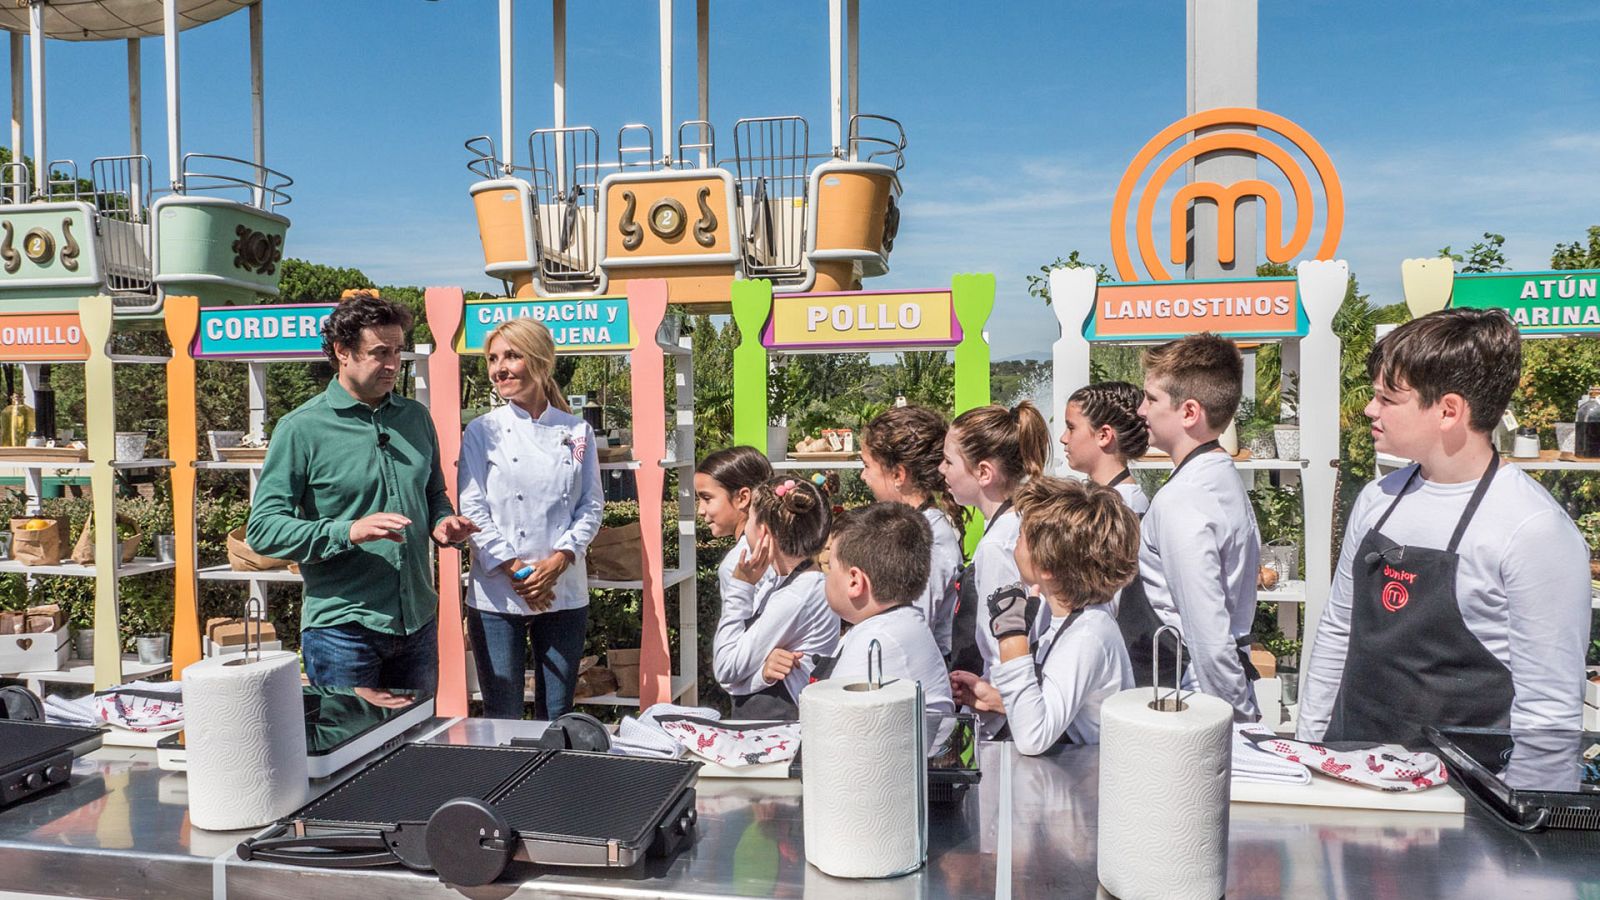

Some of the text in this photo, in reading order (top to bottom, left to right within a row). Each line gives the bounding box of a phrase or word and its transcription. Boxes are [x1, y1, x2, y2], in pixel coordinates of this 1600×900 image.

[661, 209, 673, 226] 2
[32, 237, 42, 251] 2
[1520, 275, 1598, 299] ATÚN
[478, 301, 598, 324] CALABACÍN
[807, 302, 921, 331] POLLO
[1104, 296, 1290, 319] LANGOSTINOS
[1503, 305, 1600, 325] ARINA
[0, 326, 80, 345] OMILLO
